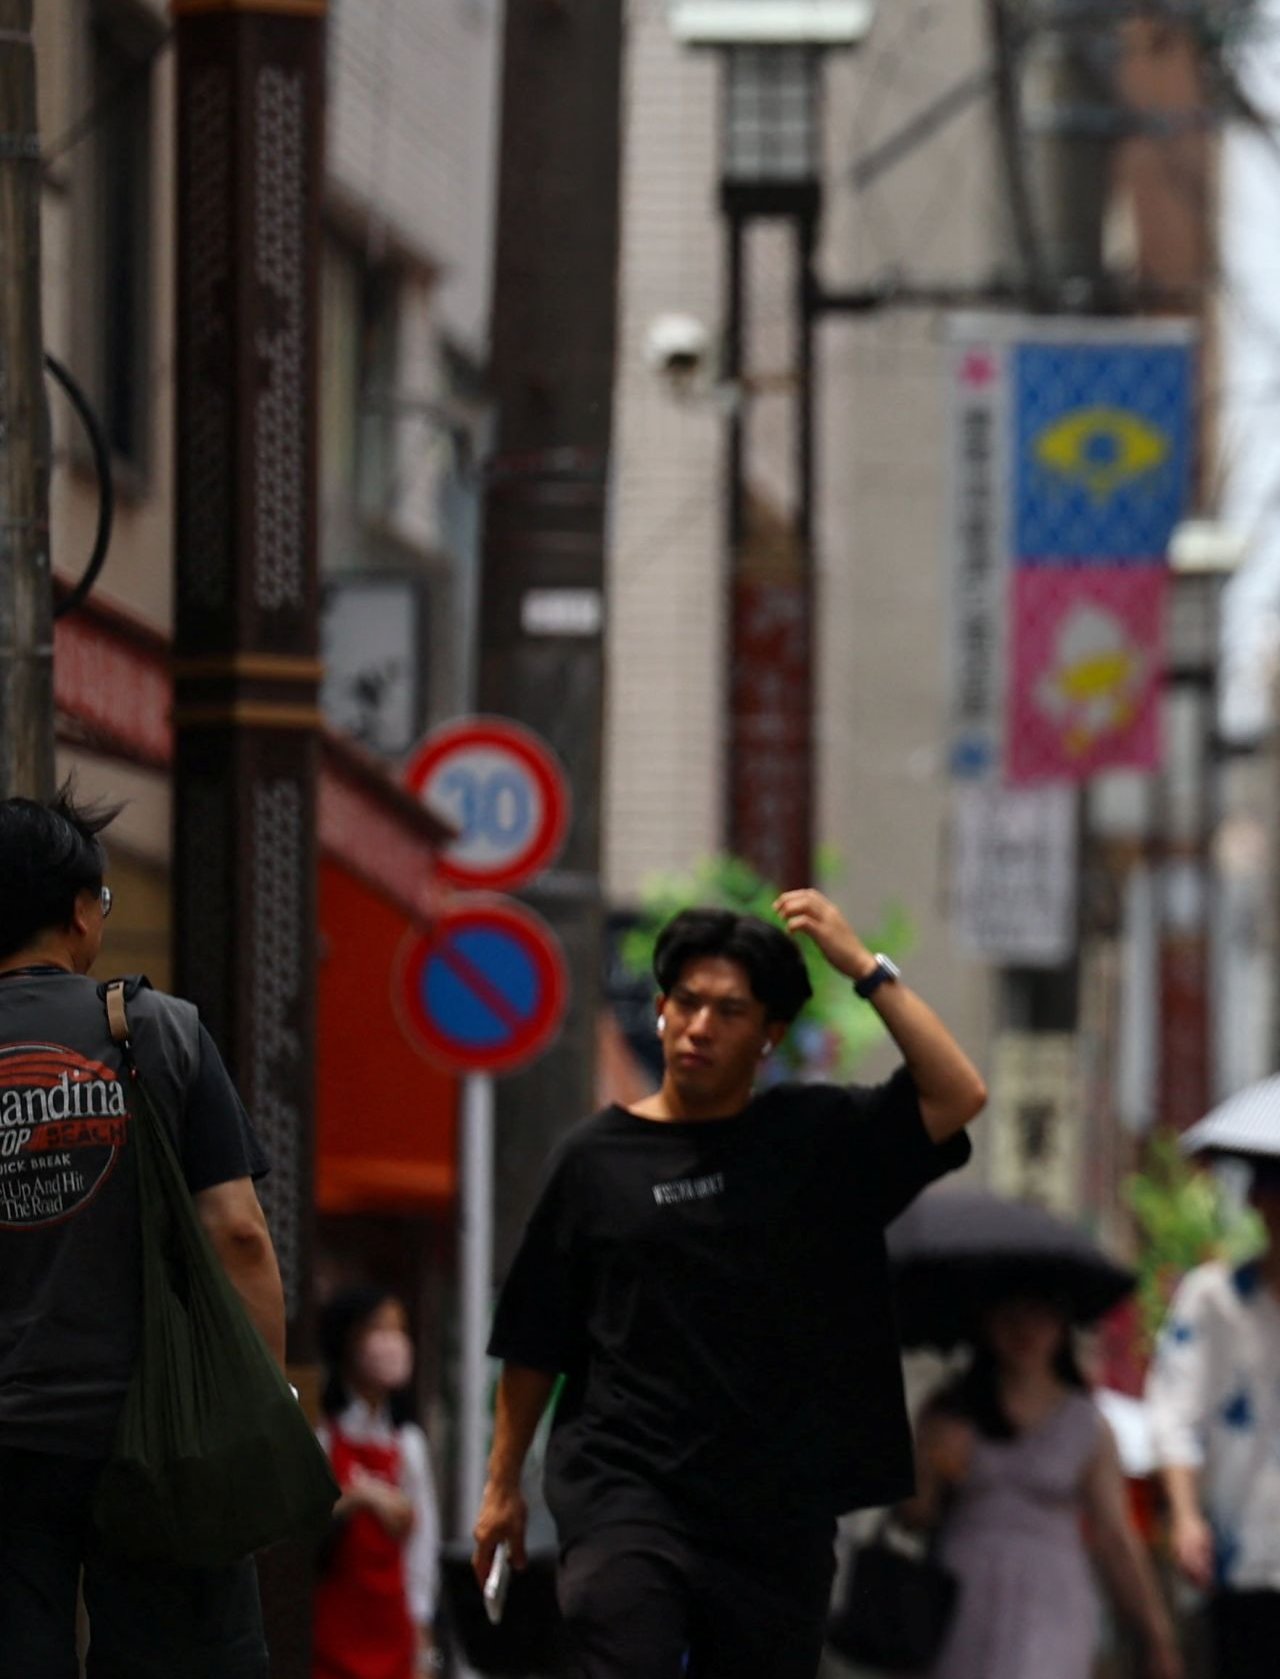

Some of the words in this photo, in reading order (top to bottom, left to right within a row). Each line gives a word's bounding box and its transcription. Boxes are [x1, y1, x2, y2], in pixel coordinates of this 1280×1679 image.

[0, 1069, 127, 1128] andina
[31, 1152, 72, 1170] BREAK
[9, 1179, 31, 1202] Up
[33, 1173, 61, 1197] And
[62, 1170, 84, 1193] Hit
[2, 1198, 31, 1220] The
